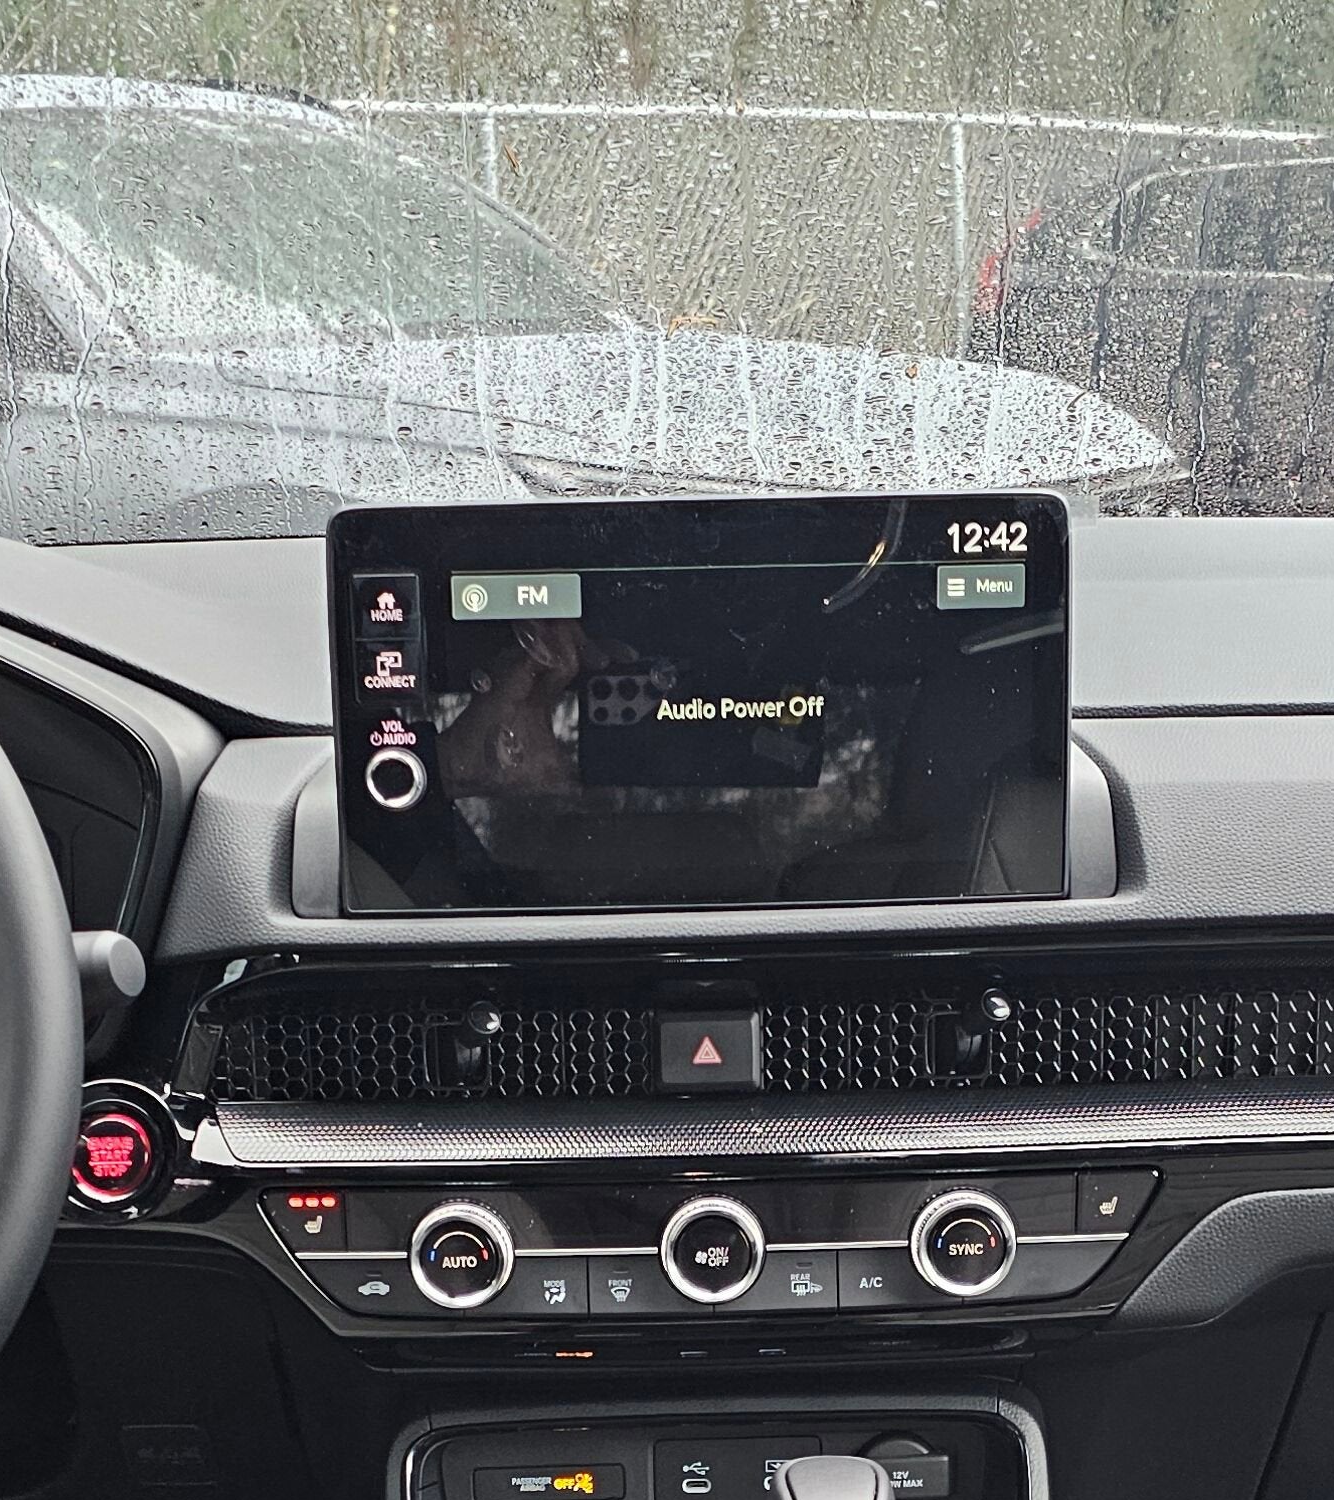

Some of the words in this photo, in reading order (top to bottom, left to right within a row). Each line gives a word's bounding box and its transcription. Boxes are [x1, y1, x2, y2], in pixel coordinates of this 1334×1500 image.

[947, 521, 1028, 553] 12:42
[976, 578, 1013, 593] Menu
[517, 585, 548, 605] FM
[370, 608, 403, 621] HOME
[364, 675, 416, 688] CONNECT
[656, 698, 716, 721] Audio
[720, 697, 786, 719] Power
[789, 695, 825, 718] Off
[381, 720, 405, 733] VOL
[383, 732, 416, 745] AUDIO
[90, 1150, 131, 1162] START
[93, 1165, 128, 1177] STOP
[948, 1243, 984, 1257] SYNC
[442, 1255, 478, 1269] AUTO
[708, 1257, 729, 1267] OFF
[543, 1279, 566, 1288] MODE
[608, 1278, 633, 1288] FRONT
[790, 1273, 811, 1281] REAR
[859, 1276, 883, 1290] A/C
[892, 1471, 910, 1480] 12V
[903, 1479, 924, 1488] MAX
